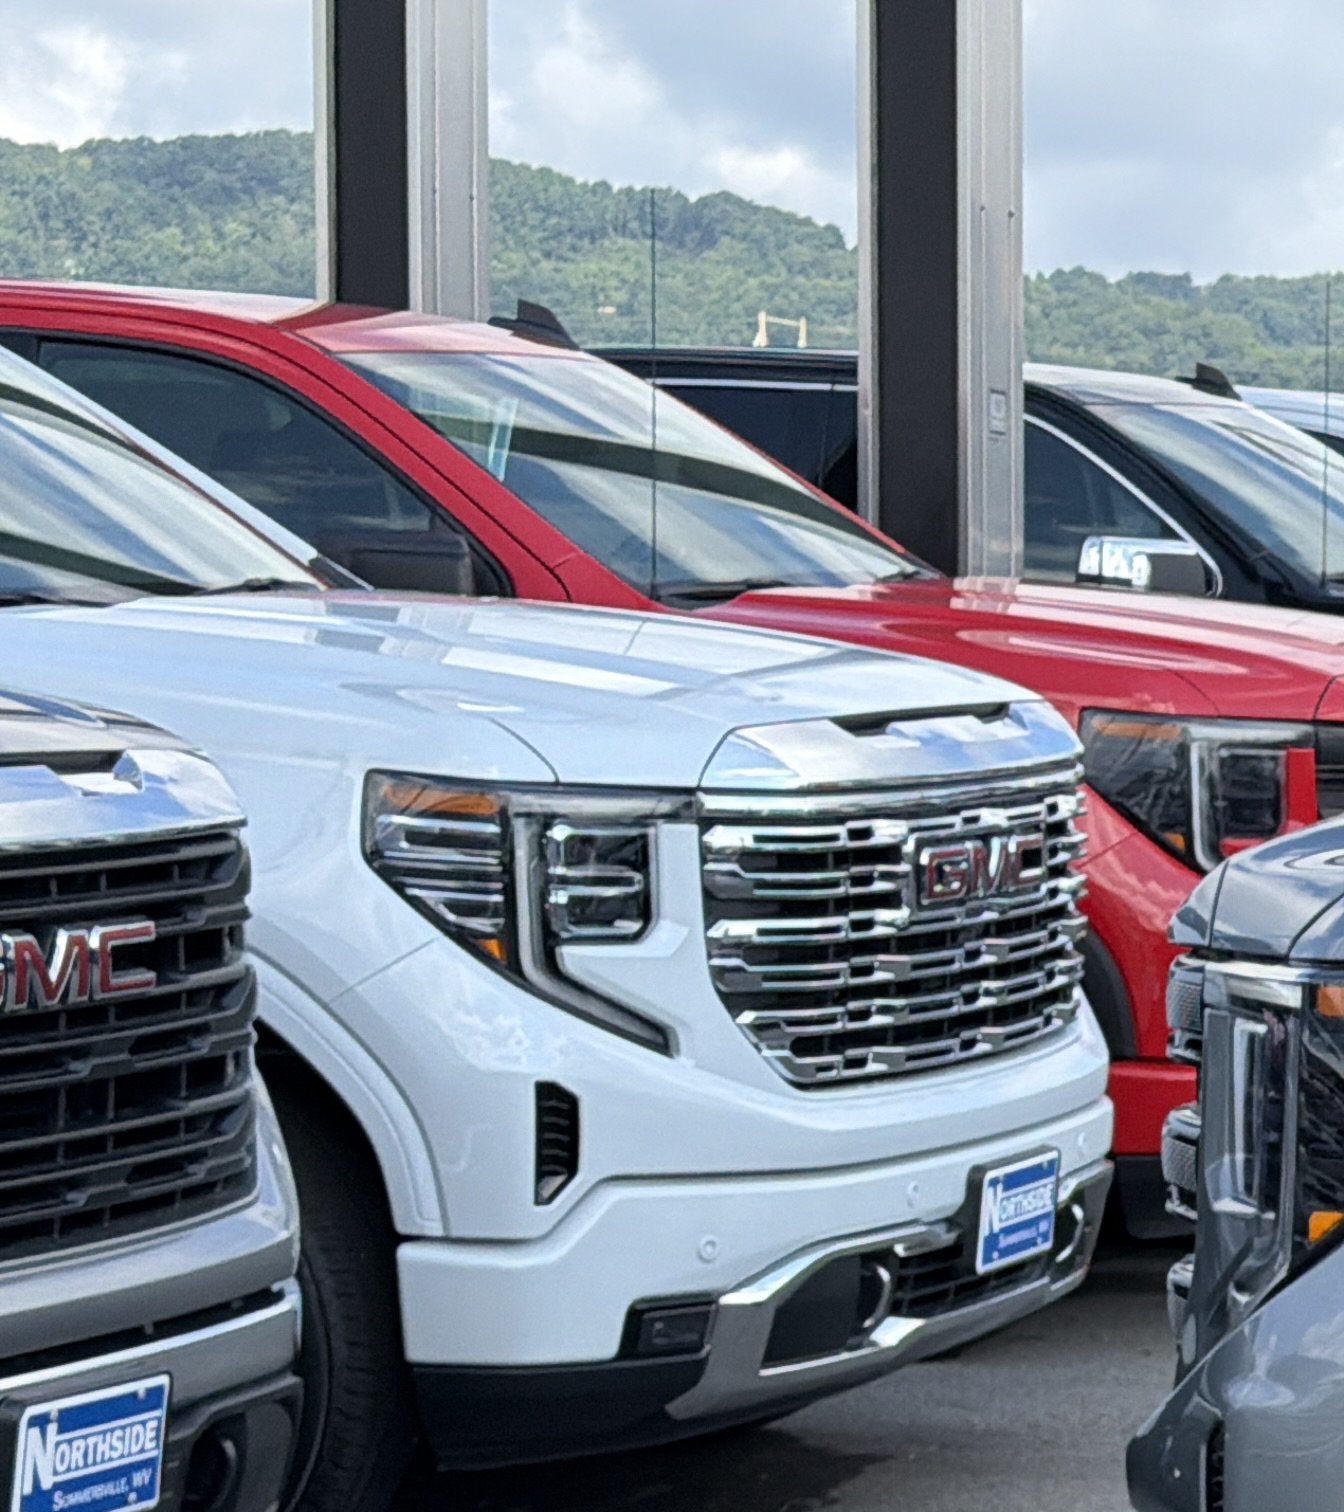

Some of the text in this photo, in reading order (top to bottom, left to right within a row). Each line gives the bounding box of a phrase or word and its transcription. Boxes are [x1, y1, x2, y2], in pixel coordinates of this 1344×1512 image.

[920, 834, 1043, 905] GMC
[0, 920, 157, 1012] MC
[22, 1420, 159, 1497] NORTHSIDE
